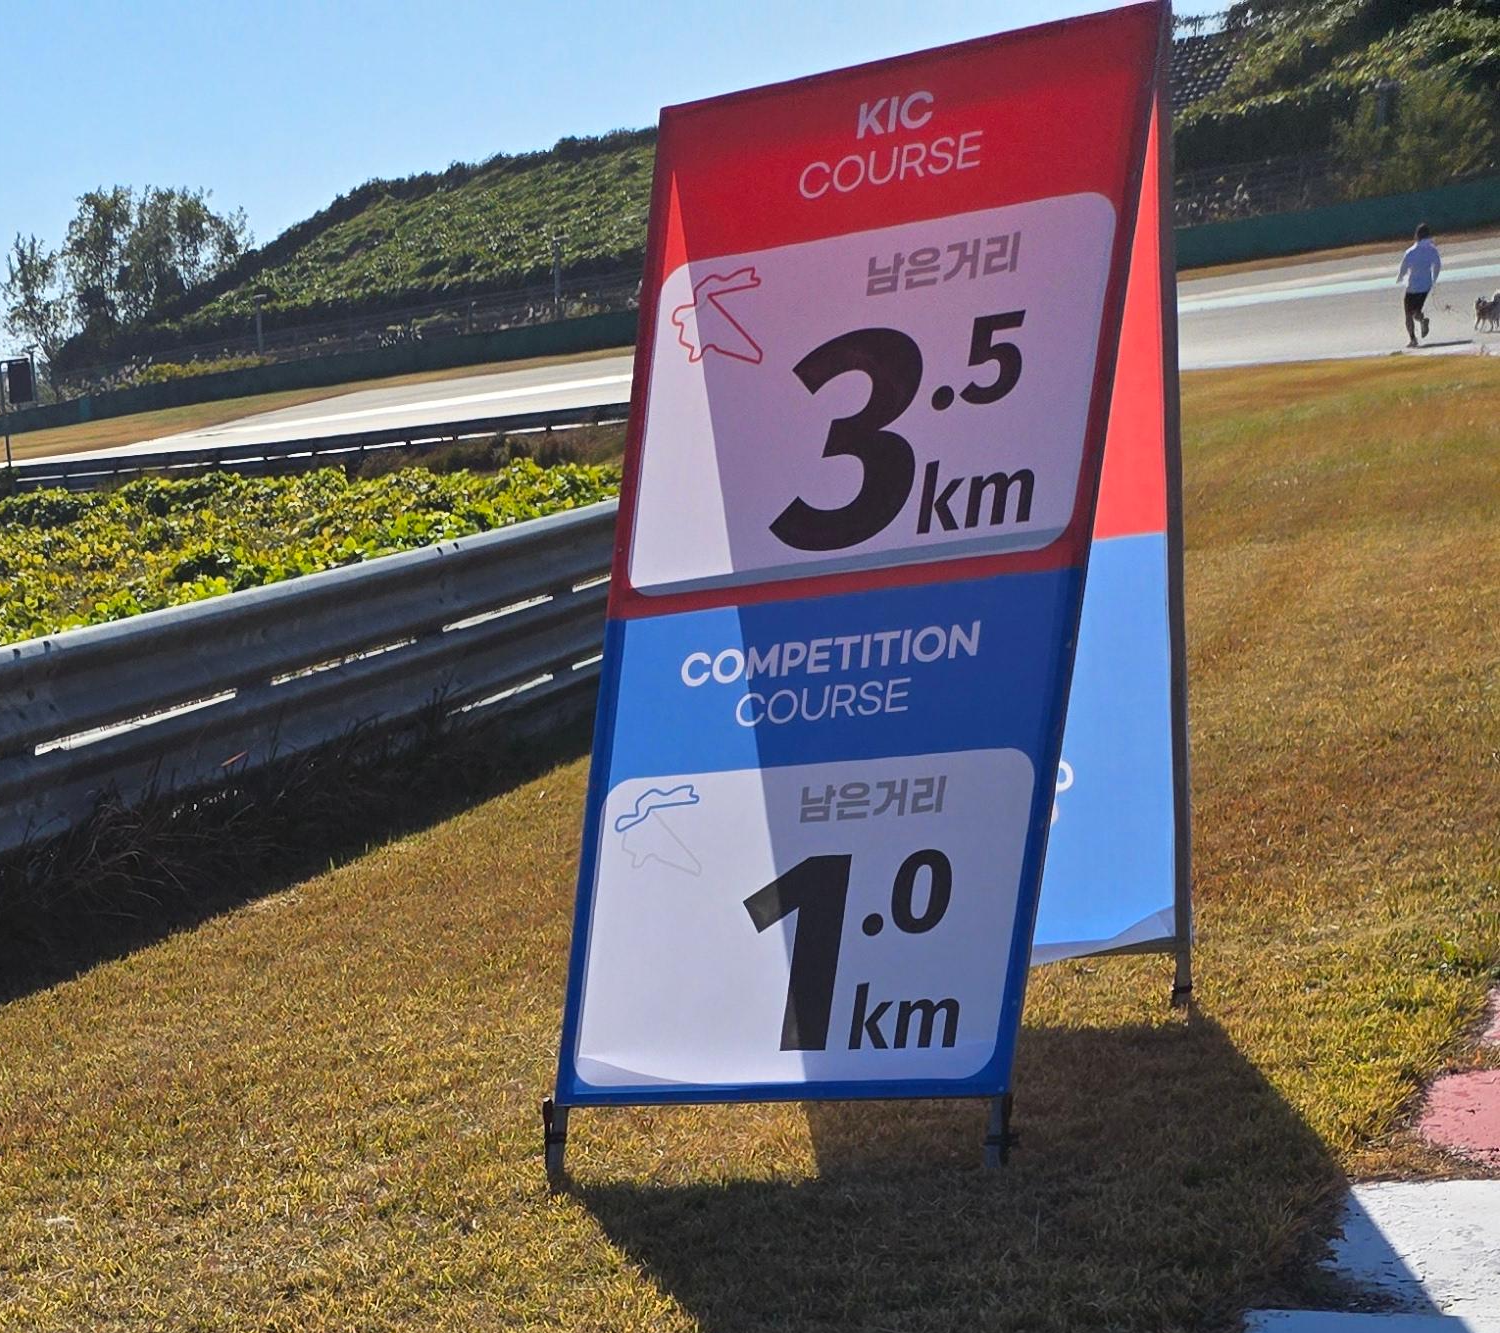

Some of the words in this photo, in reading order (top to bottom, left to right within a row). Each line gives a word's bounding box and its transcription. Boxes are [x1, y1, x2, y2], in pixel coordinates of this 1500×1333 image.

[856, 90, 934, 139] KIC
[799, 131, 983, 200] COURSE
[865, 231, 1021, 297] 남은거리
[768, 310, 1025, 552] 3.5
[916, 460, 1035, 535] km
[680, 620, 981, 687] COMPETITION
[734, 677, 911, 728] COURSE
[799, 775, 948, 823] 남은거리
[742, 848, 953, 1052] 1.0
[848, 982, 960, 1050] km
